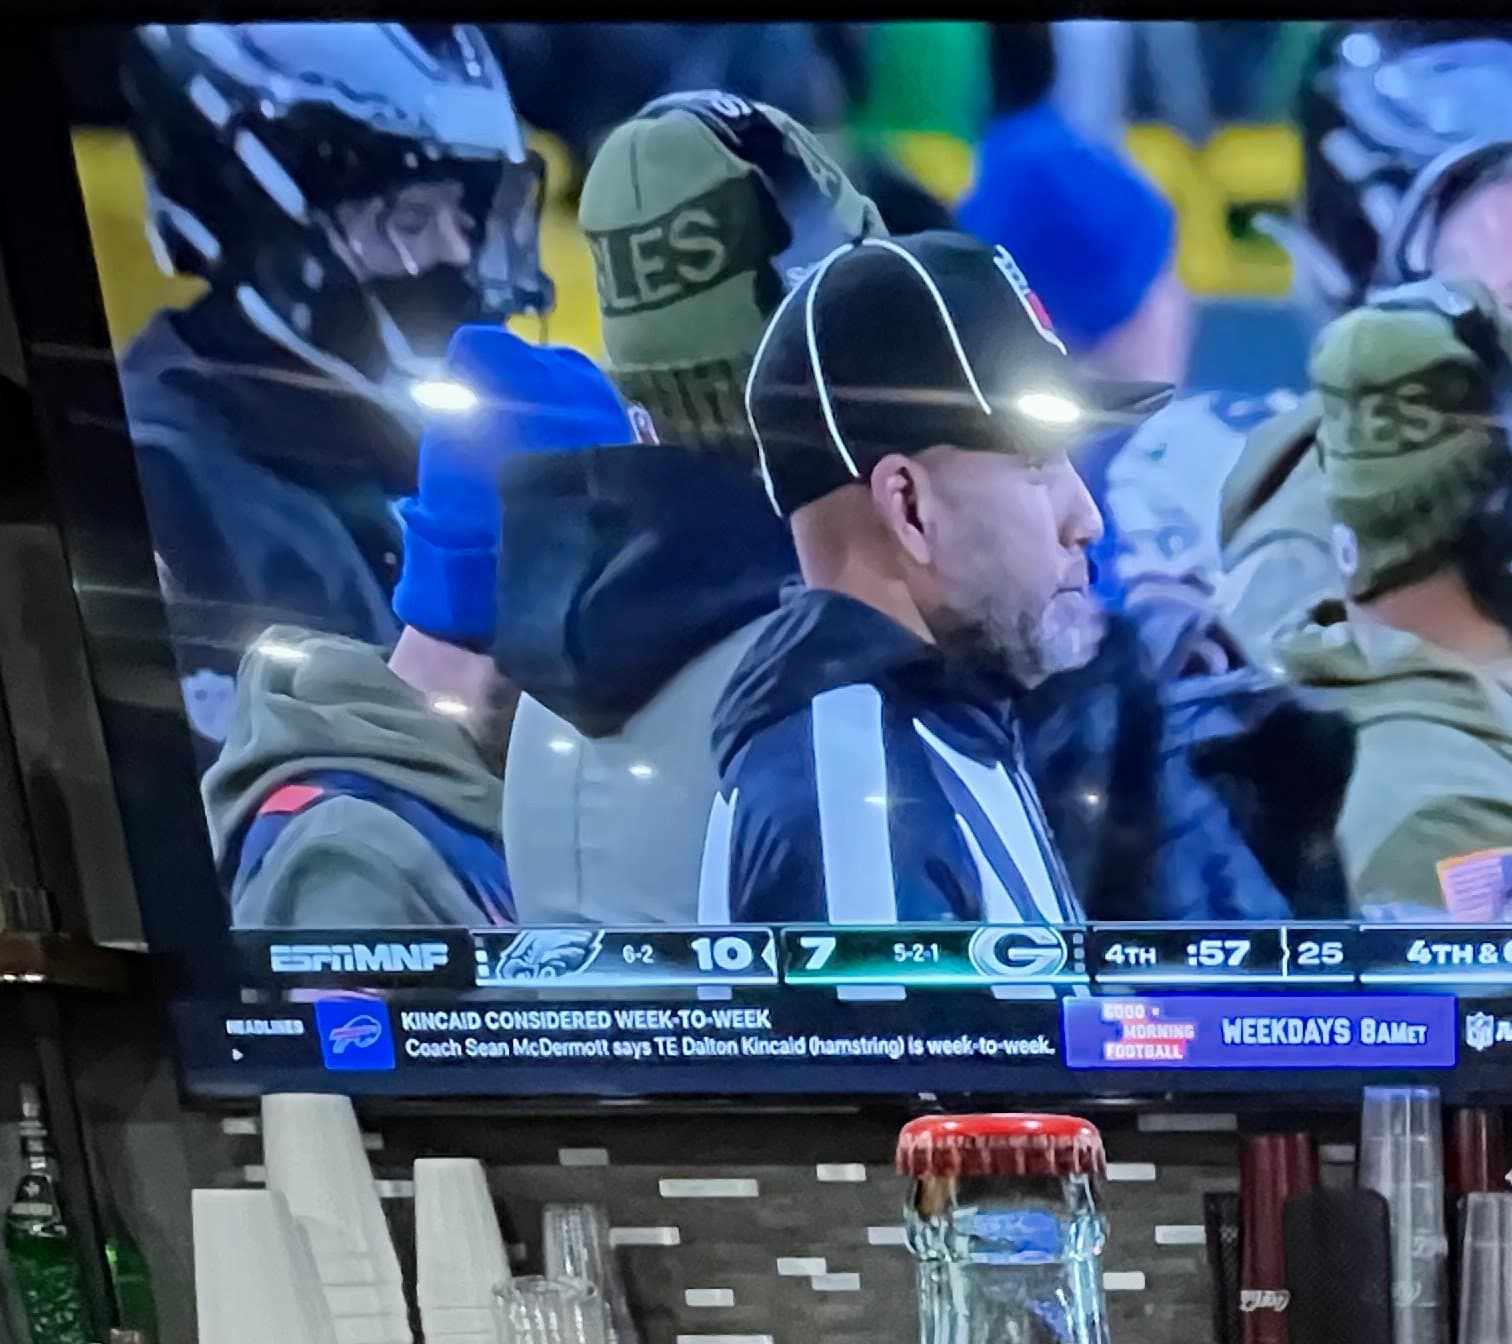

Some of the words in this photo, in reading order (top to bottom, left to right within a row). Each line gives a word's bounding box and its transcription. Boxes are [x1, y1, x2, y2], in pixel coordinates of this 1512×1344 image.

[622, 945, 654, 963] 6-2
[691, 937, 752, 970] 10
[800, 937, 837, 970] 7
[894, 943, 939, 962] 5-2-1
[1297, 941, 1344, 964] 25
[1478, 943, 1498, 964] &
[401, 1011, 481, 1031] KINCAID
[485, 1010, 611, 1030] CONSIDERED
[615, 1008, 772, 1030] WEEK-TO-WEEK
[1222, 1017, 1351, 1044] WEEKDAYS
[1123, 1023, 1195, 1040] MORNING
[406, 1039, 460, 1058] Coach
[465, 1039, 507, 1057] Sean
[512, 1038, 609, 1058] McDermott
[612, 1042, 651, 1061] says
[655, 1037, 679, 1056] TE
[682, 1037, 739, 1057] Dalton
[742, 1036, 805, 1056] Kincaid
[809, 1036, 904, 1061] (hamstring)
[908, 1036, 924, 1055] is
[927, 1035, 1055, 1056] week-to-week.
[1104, 1042, 1184, 1061] FOOTBALL
